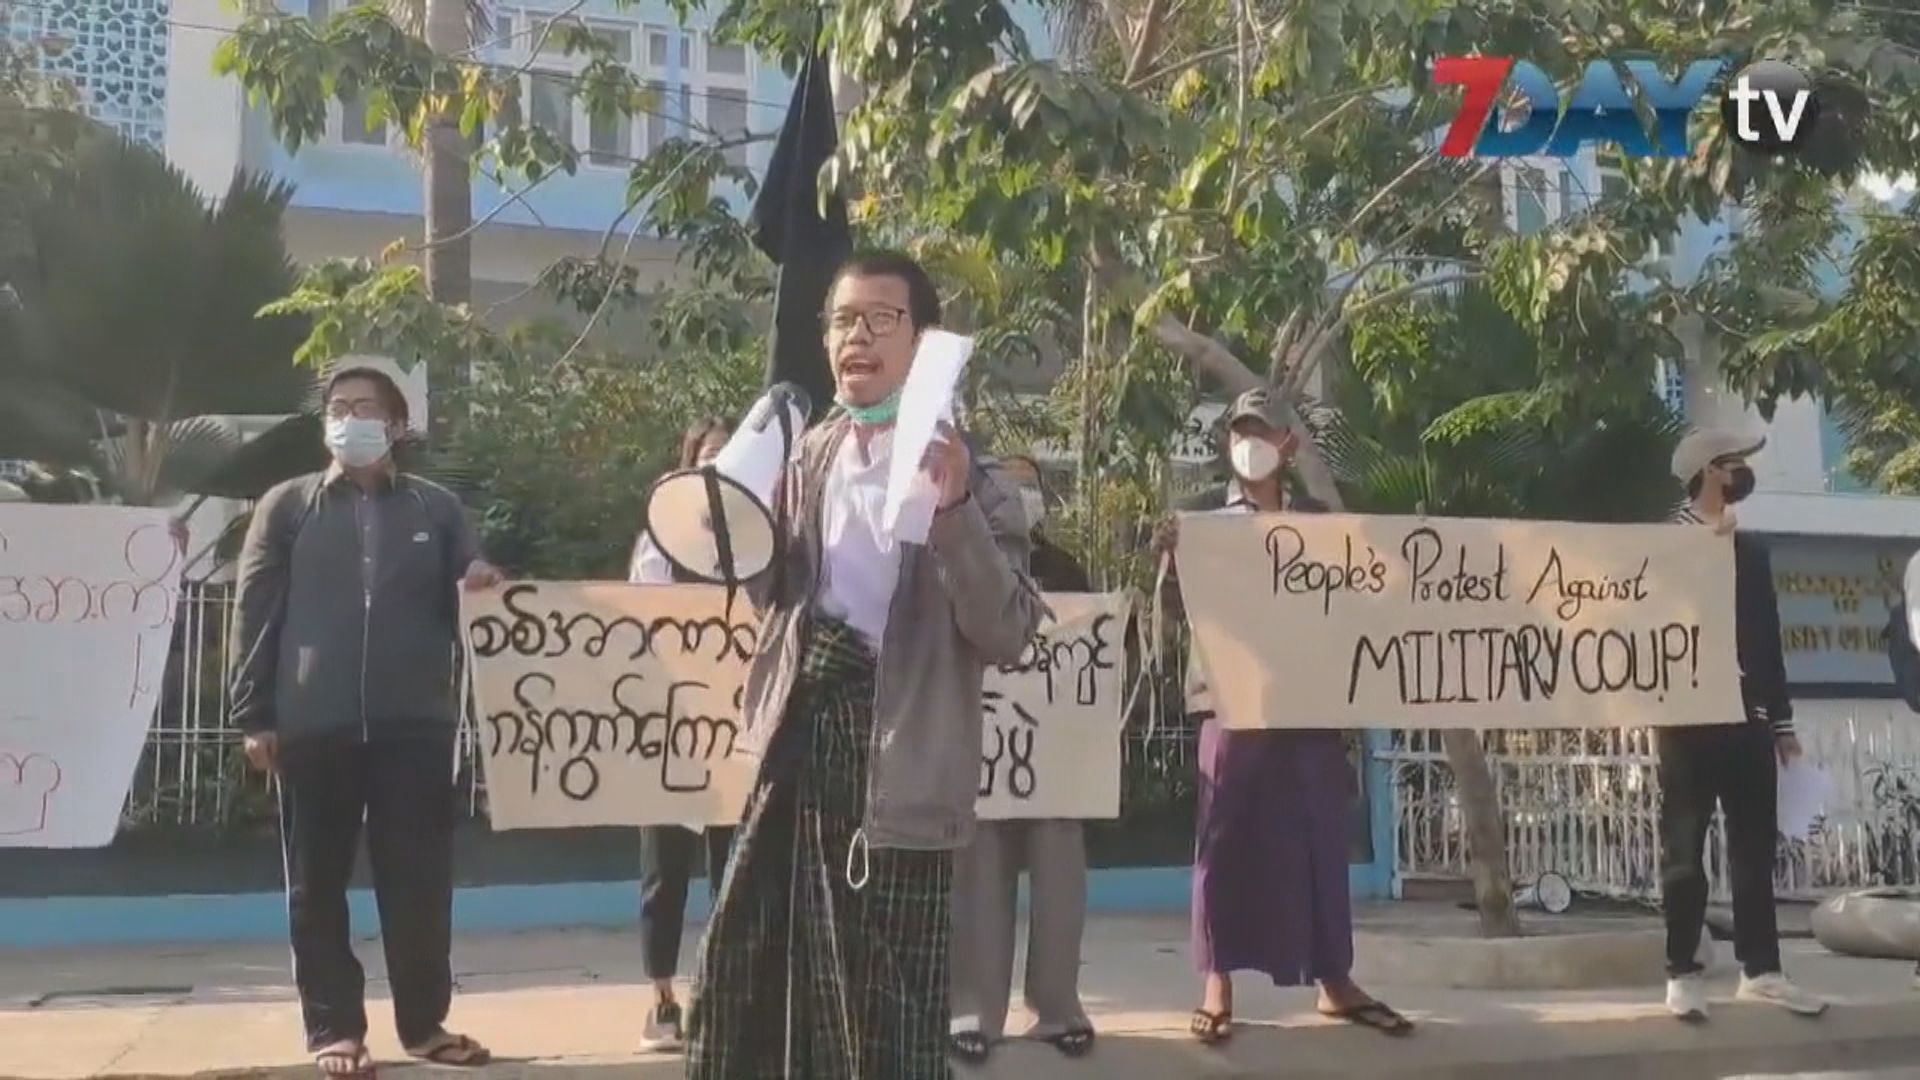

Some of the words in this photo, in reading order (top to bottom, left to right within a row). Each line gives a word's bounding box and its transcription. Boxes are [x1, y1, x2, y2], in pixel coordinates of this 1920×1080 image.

[1266, 525, 1388, 616] People's
[1402, 526, 1509, 604] Protest
[1526, 546, 1650, 621] Against
[1348, 623, 1562, 705] MILITARY
[1571, 622, 1702, 704] COUP!
